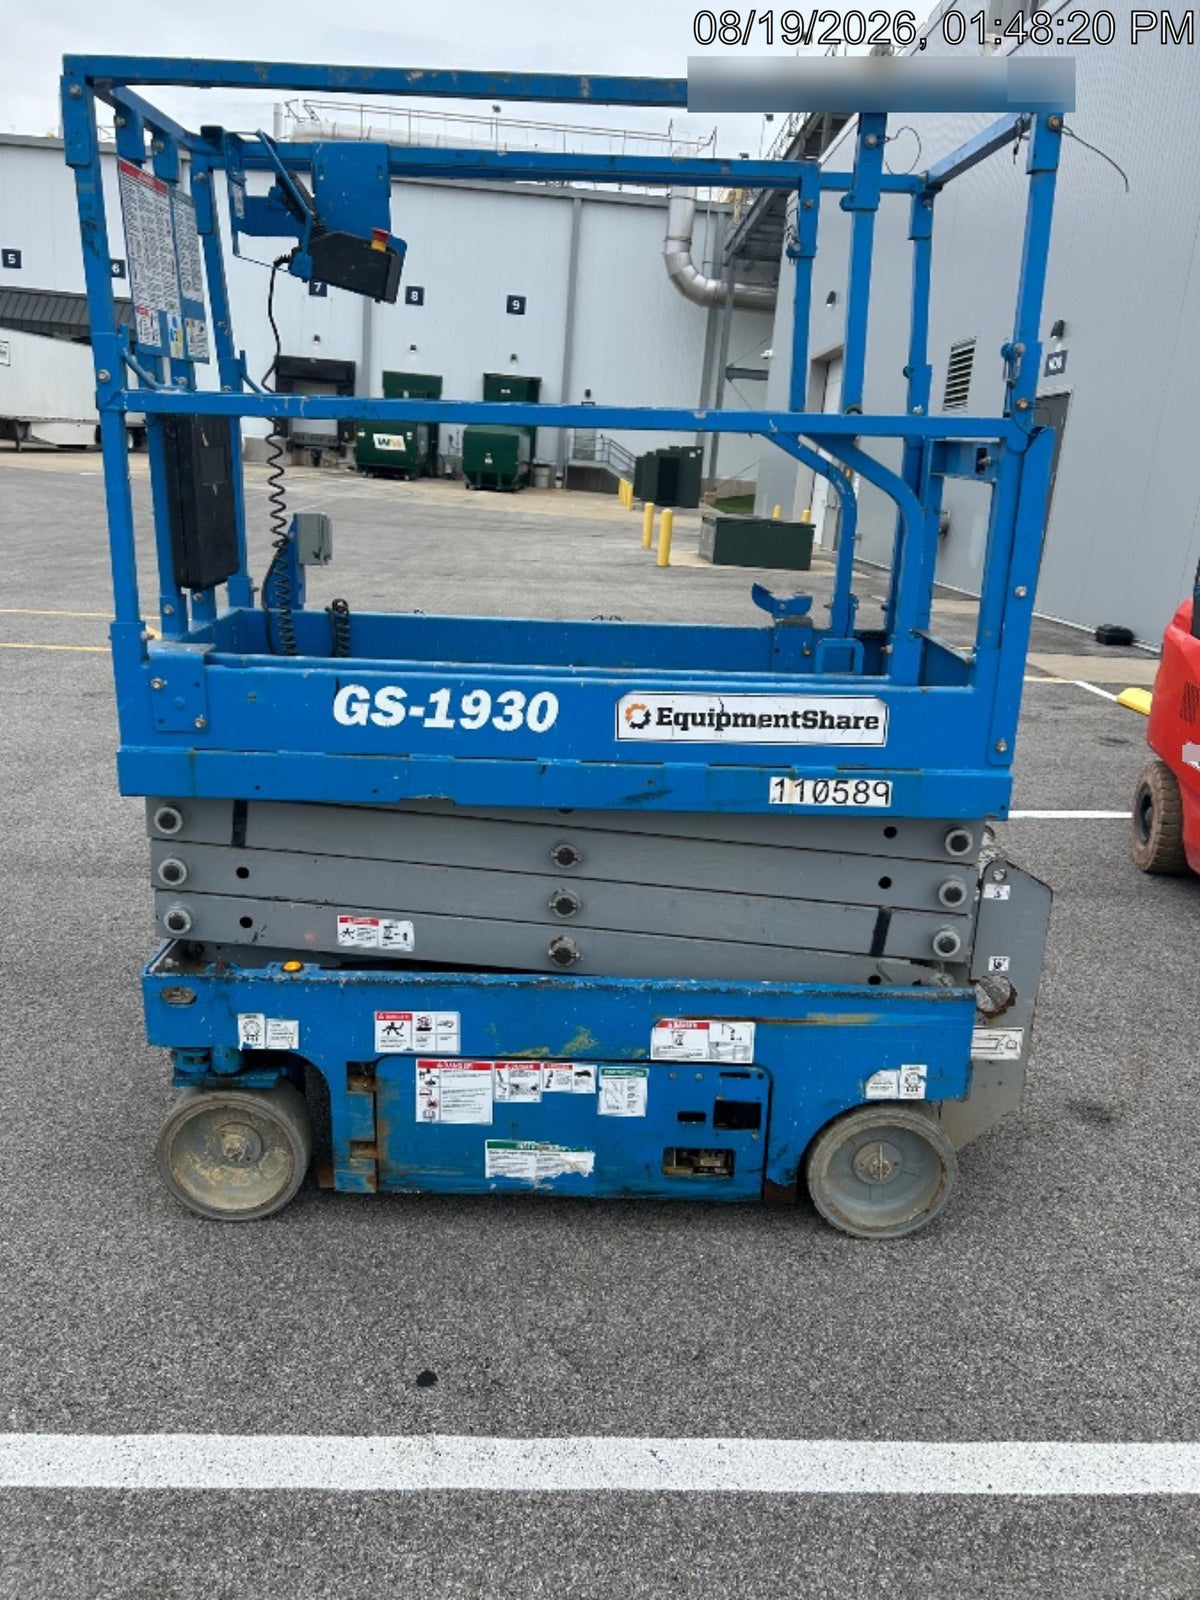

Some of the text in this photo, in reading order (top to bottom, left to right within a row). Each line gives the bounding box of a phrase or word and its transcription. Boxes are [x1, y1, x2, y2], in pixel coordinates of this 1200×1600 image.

[8, 253, 16, 264] 5
[112, 262, 120, 274] 6
[314, 282, 322, 292] 7
[411, 290, 419, 301] 8
[511, 299, 520, 310] 9
[333, 684, 559, 733] GS-1930
[655, 706, 879, 732] EquipmentShare
[772, 778, 891, 806] 110589
